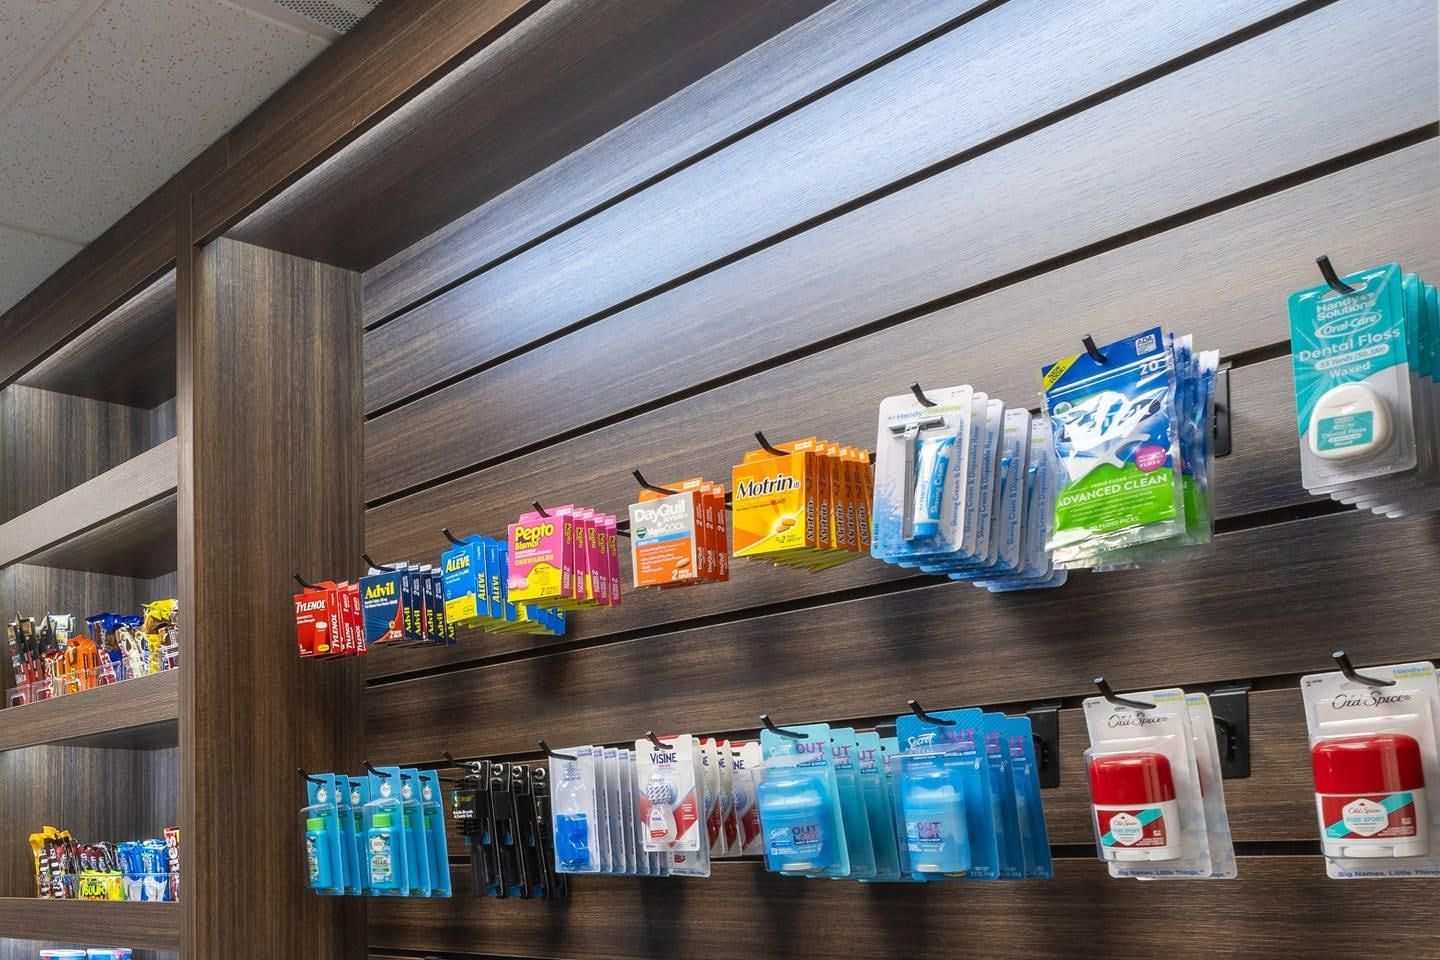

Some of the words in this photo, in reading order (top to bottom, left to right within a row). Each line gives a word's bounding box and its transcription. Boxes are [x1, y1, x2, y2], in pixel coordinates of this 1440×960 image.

[1137, 335, 1154, 345] ADA
[1299, 337, 1353, 361] Dental
[1358, 328, 1401, 347] Floss
[1329, 361, 1371, 379] Waxed
[935, 462, 945, 484] Cream
[737, 474, 793, 498] Motrin
[1058, 484, 1121, 508] ADVANCED
[1124, 473, 1168, 490] CLEAN
[931, 484, 942, 514] Shaving
[634, 499, 686, 523] DayQuil
[514, 523, 555, 543] Pepto
[514, 537, 539, 551] Bismol
[672, 569, 678, 580] 2
[365, 581, 395, 599] Advil
[295, 599, 326, 614] TYLENOL
[404, 607, 412, 633] Advil
[426, 609, 435, 635] Advil
[437, 613, 445, 638] Advil
[1331, 694, 1361, 710] Old
[796, 741, 825, 754] OUT
[907, 732, 937, 750] Secret
[650, 752, 678, 765] VISINE
[832, 745, 850, 757] UT
[792, 825, 817, 835] OUT
[82, 884, 107, 896] SOUR
